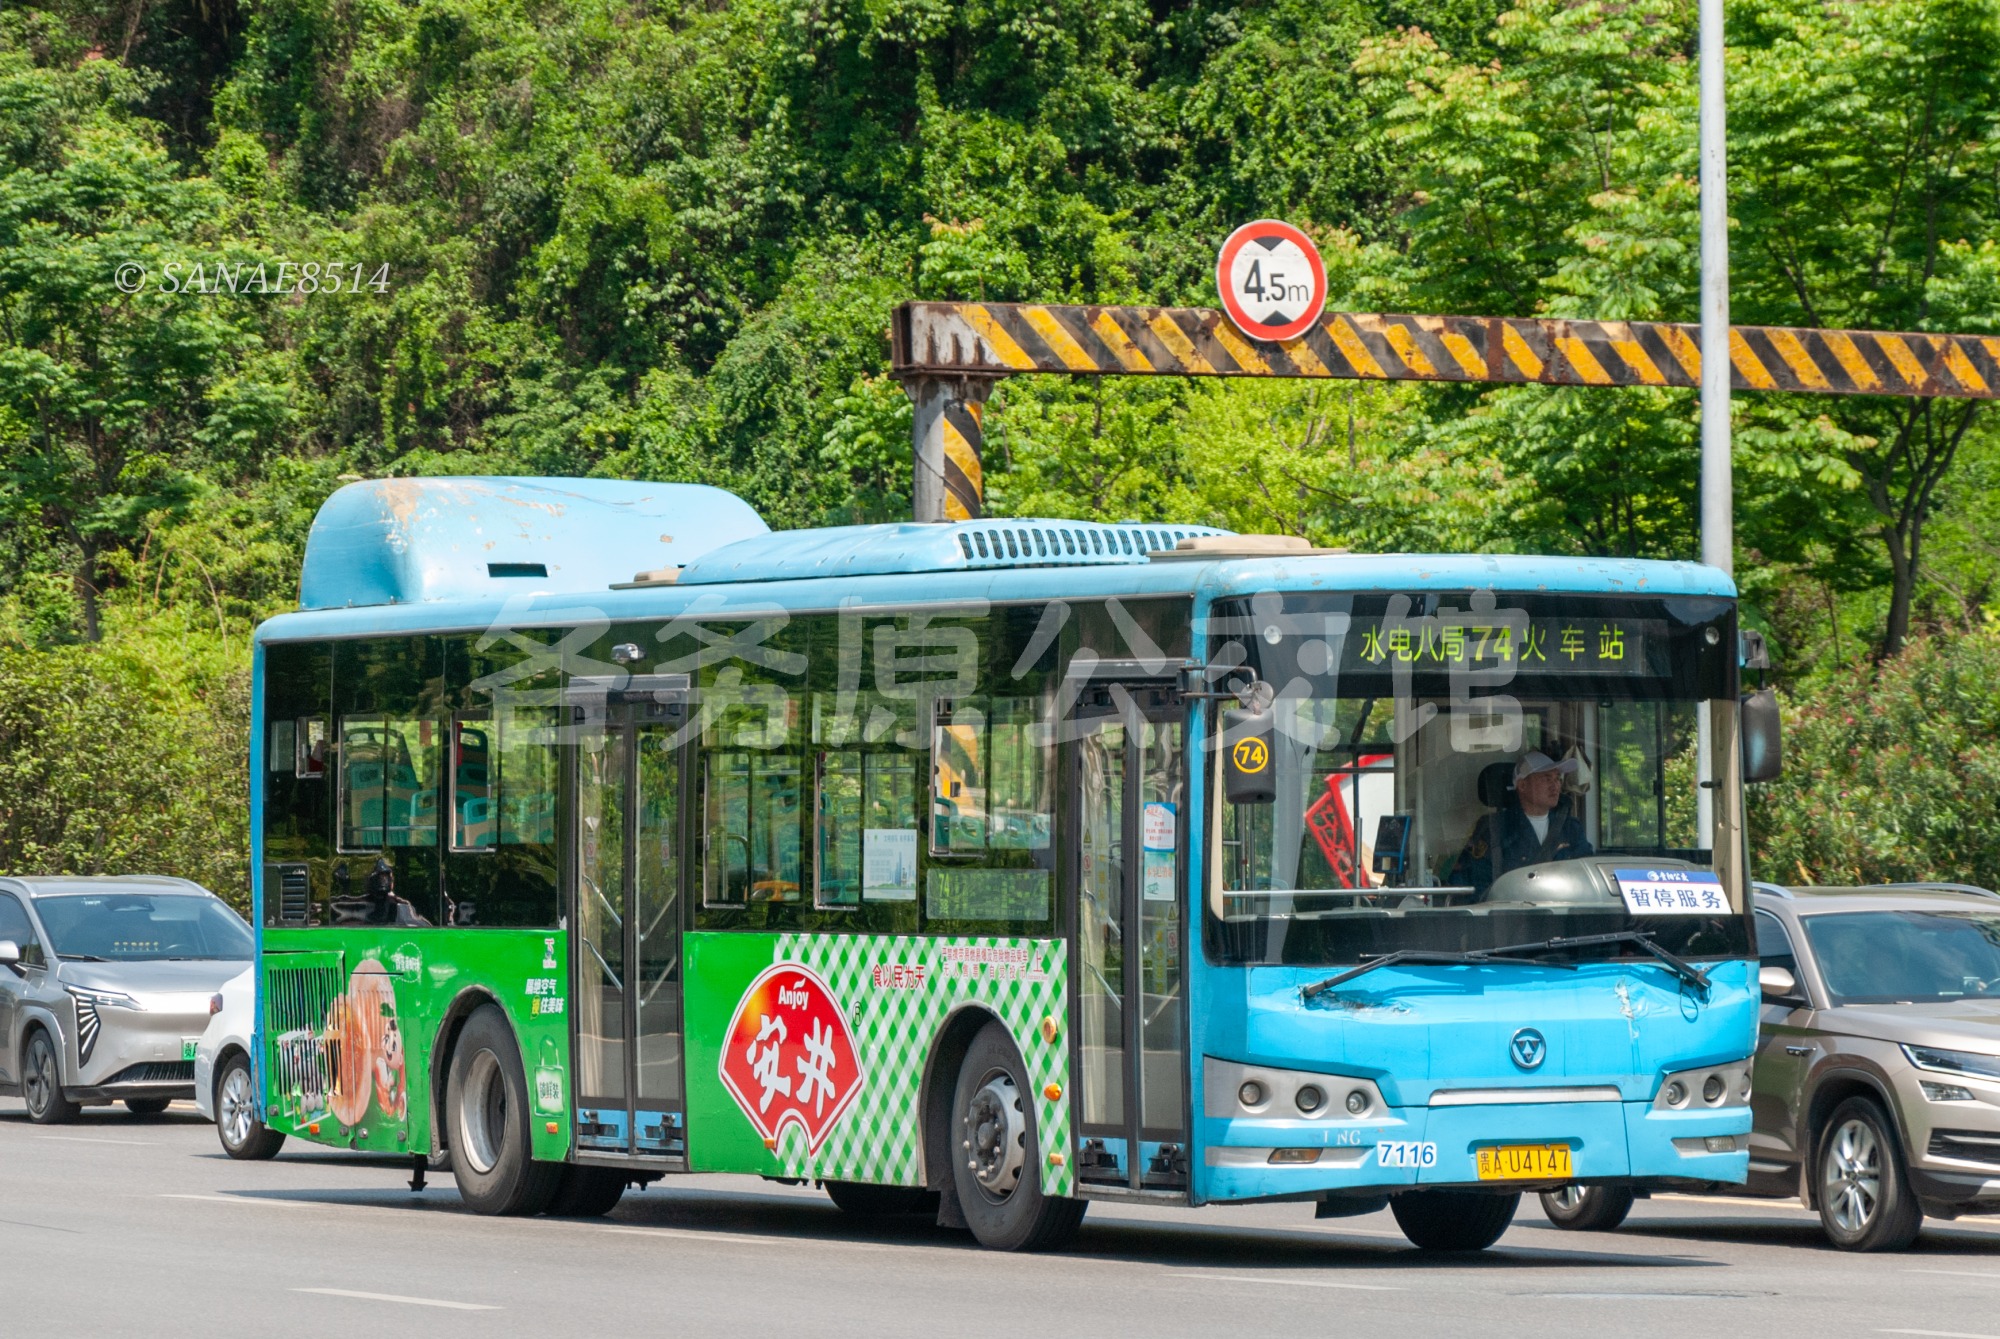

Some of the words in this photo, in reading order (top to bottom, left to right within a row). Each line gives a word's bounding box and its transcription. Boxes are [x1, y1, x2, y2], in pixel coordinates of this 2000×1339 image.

[1243, 258, 1309, 302] 4.5m
[1239, 745, 1264, 765] 74
[1630, 888, 1721, 909] 暂停服务
[1033, 950, 1044, 973] 上
[872, 964, 925, 989] 食以民为天
[777, 977, 810, 1011] Anjoy
[746, 1013, 836, 1120] 安井
[1379, 1144, 1434, 1164] 7116
